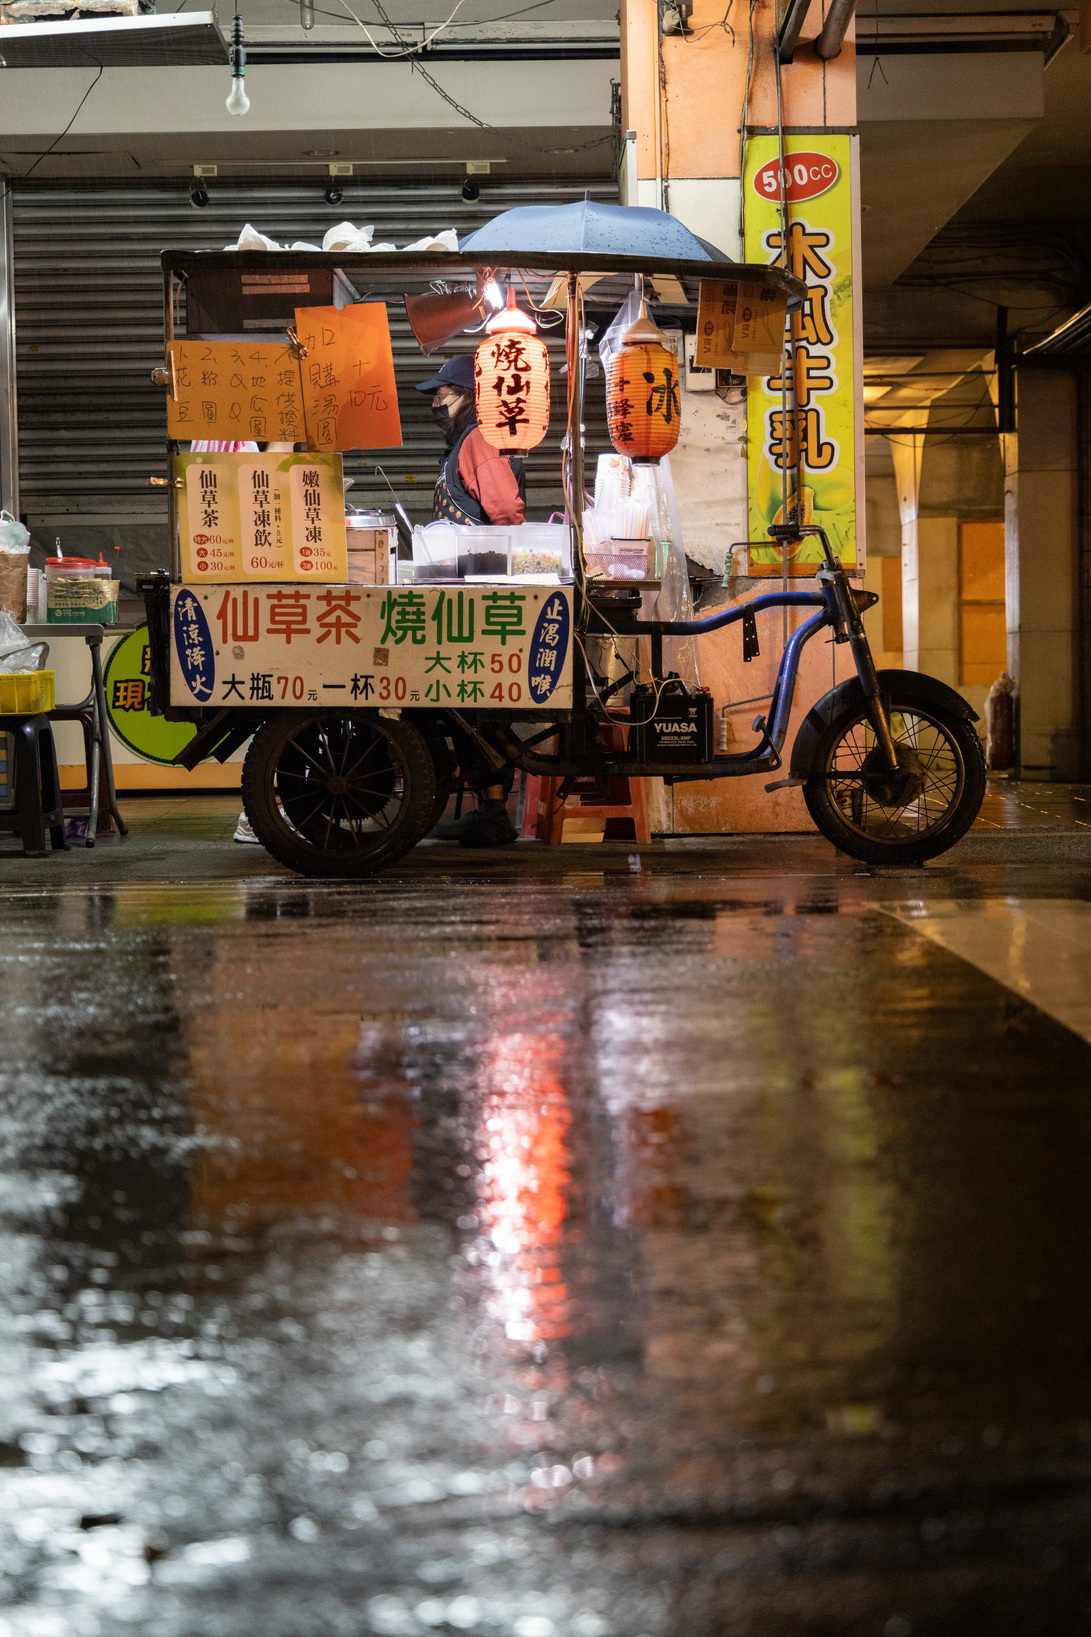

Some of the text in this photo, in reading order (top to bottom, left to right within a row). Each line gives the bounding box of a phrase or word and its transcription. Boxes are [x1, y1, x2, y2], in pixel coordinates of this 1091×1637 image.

[491, 339, 532, 437] 燒仙草
[642, 367, 681, 425] 冰
[199, 470, 219, 528] 仙草茶
[251, 470, 272, 548] 仙草凍飲
[302, 470, 323, 544] 嫩仙草凍
[177, 597, 213, 695] 清涼降火
[216, 590, 361, 645] 仙草茶
[380, 590, 526, 646] 燒仙草
[531, 598, 563, 697] 止渴潤喉
[654, 722, 698, 733] YUASA
